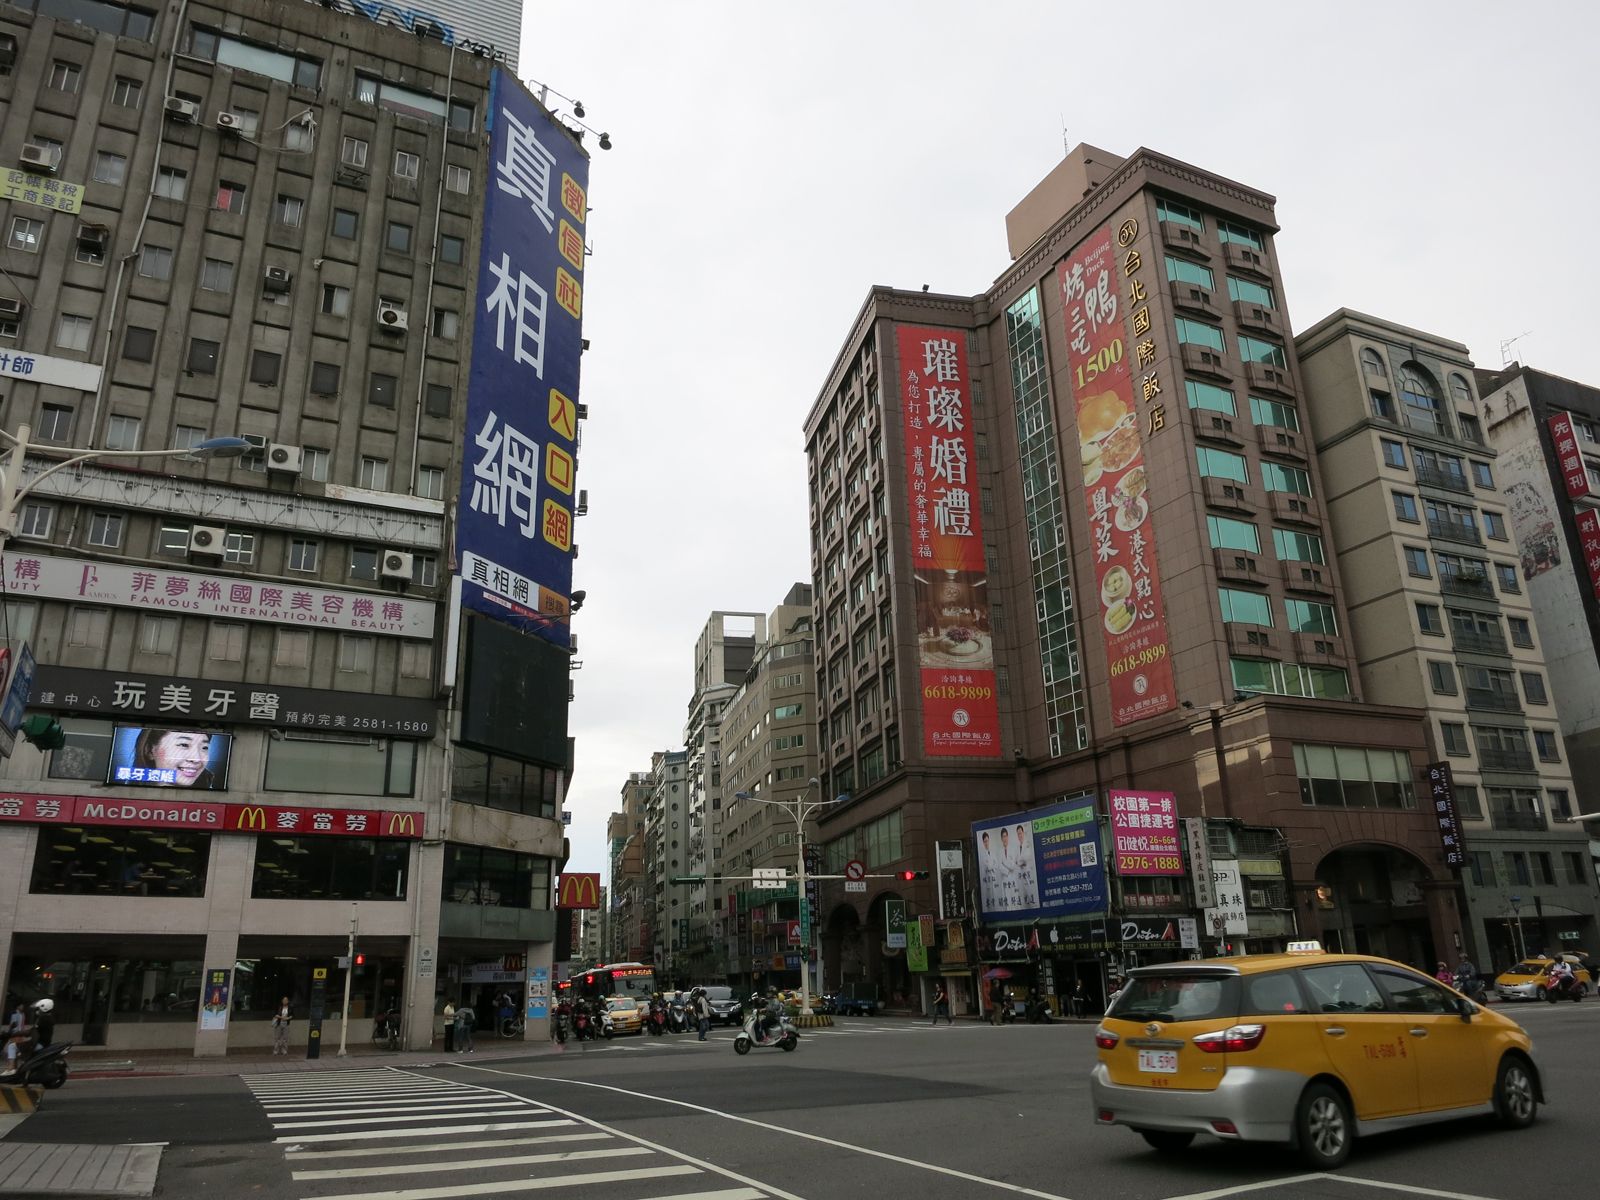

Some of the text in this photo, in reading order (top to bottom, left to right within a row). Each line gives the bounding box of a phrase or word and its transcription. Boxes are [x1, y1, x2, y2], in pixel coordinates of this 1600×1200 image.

[4, 185, 74, 211] 工商登記
[8, 170, 78, 198] 記帳報稅
[558, 178, 584, 315] 徵信社
[1084, 240, 1110, 266] Beijing
[1086, 258, 1105, 278] Duck
[470, 107, 556, 539] 真相網
[1123, 249, 1165, 437] 台北國際飯店
[1075, 338, 1124, 391] 1500
[921, 339, 974, 538] 璀璨婚禮
[1553, 421, 1585, 490] 先探週刊
[545, 394, 573, 548] 入口網
[1089, 486, 1119, 564] 粵菜
[471, 557, 529, 604] 真相網
[1128, 529, 1156, 622] 港式點心
[130, 594, 405, 632] FAMOUS INTERNATIONAL BEAUTY
[131, 572, 404, 622] 菲夢絲國際美容機構
[1111, 643, 1166, 677] 6618-9899
[112, 681, 280, 721] 玩美牙醫
[924, 685, 991, 700] 6618-9899
[285, 711, 347, 728] 預約完美
[352, 717, 428, 732] 2581-1580
[84, 803, 217, 823] McDonald's
[277, 811, 367, 831] 麥當勞
[1114, 796, 1172, 813] 校園第一排
[1115, 813, 1174, 829] 公園捷運宅
[1430, 768, 1457, 863] 台北國際飯店
[1120, 856, 1180, 870] 2976-1888
[1121, 922, 1160, 941] Doctor
[1288, 942, 1315, 951] TAXI
